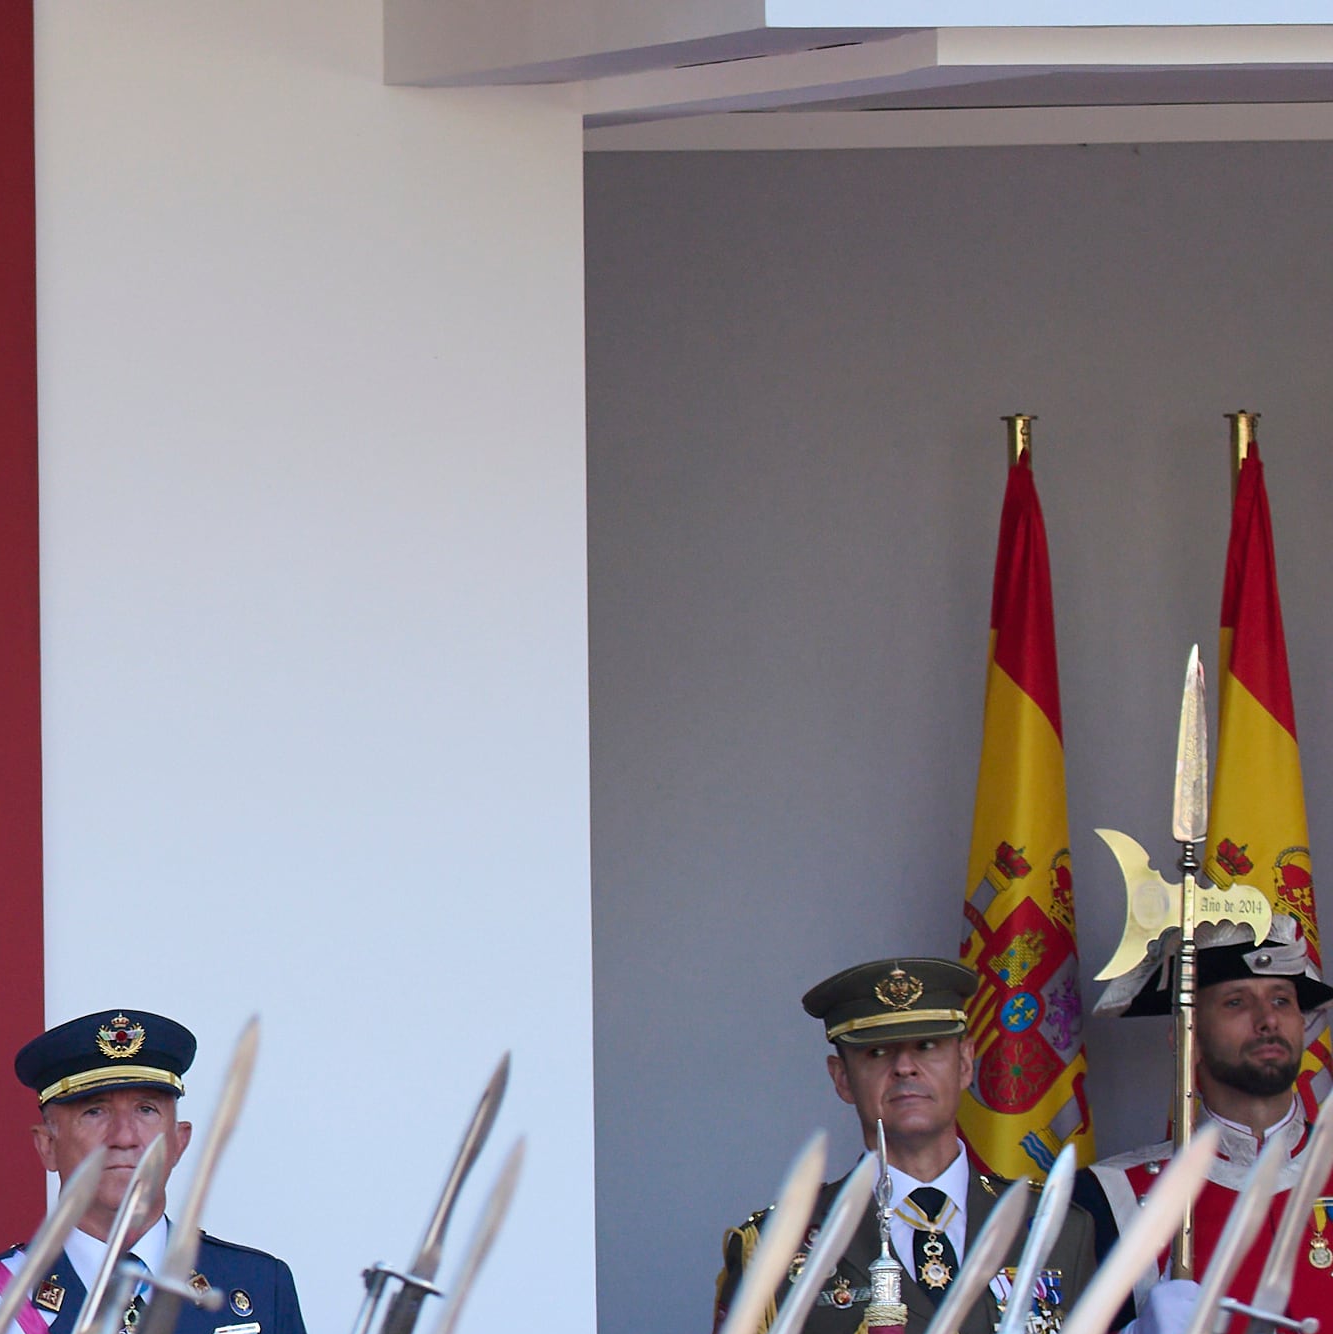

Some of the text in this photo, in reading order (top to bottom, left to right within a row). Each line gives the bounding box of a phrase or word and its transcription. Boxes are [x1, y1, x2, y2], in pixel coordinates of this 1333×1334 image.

[1201, 897, 1262, 914] Año de 2014
